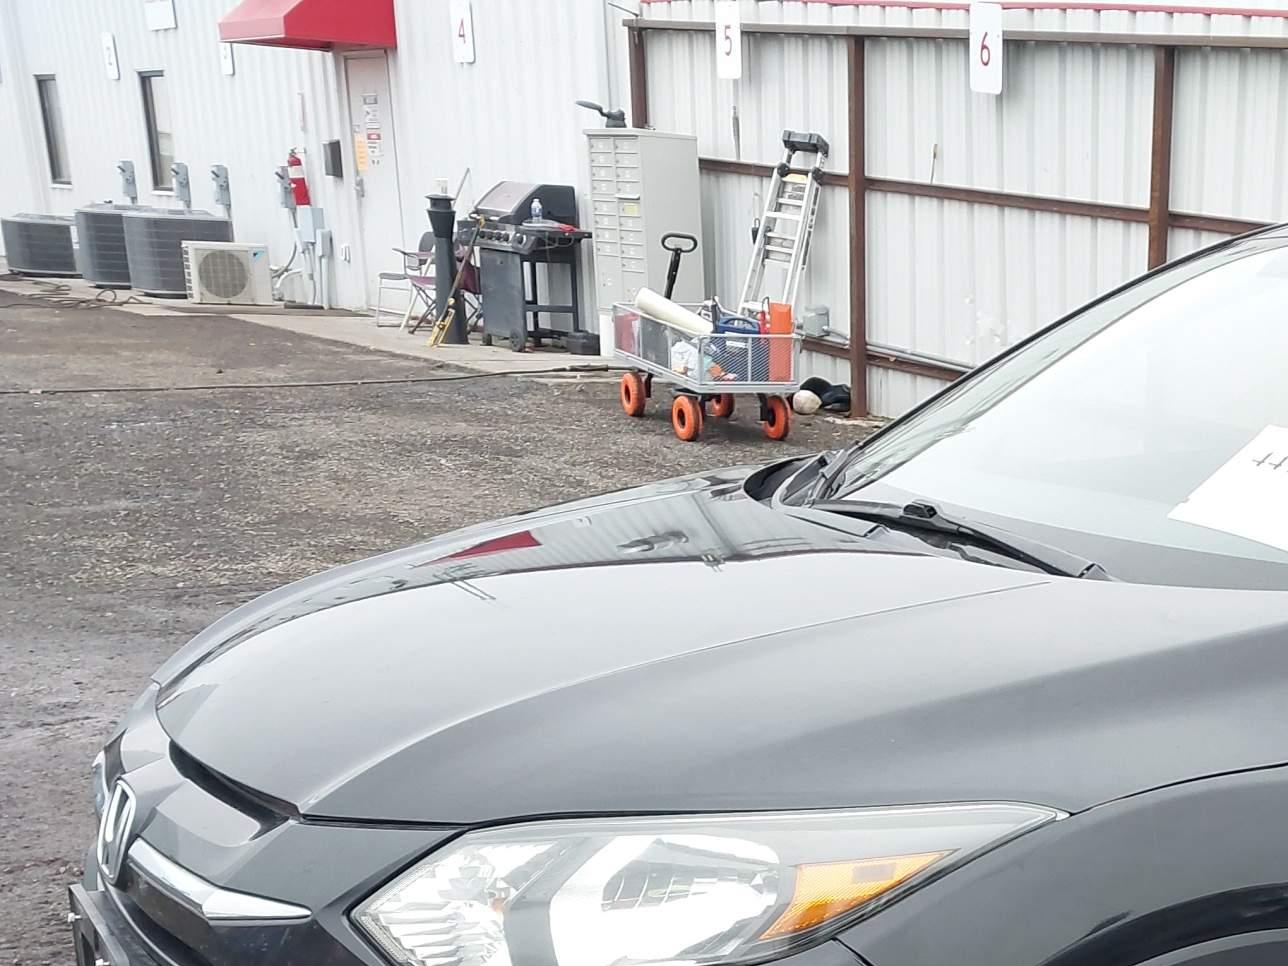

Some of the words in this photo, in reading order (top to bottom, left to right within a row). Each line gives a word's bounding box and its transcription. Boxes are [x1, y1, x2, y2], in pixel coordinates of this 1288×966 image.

[458, 18, 466, 44] 4
[724, 24, 733, 56] 5
[980, 31, 991, 66] 6
